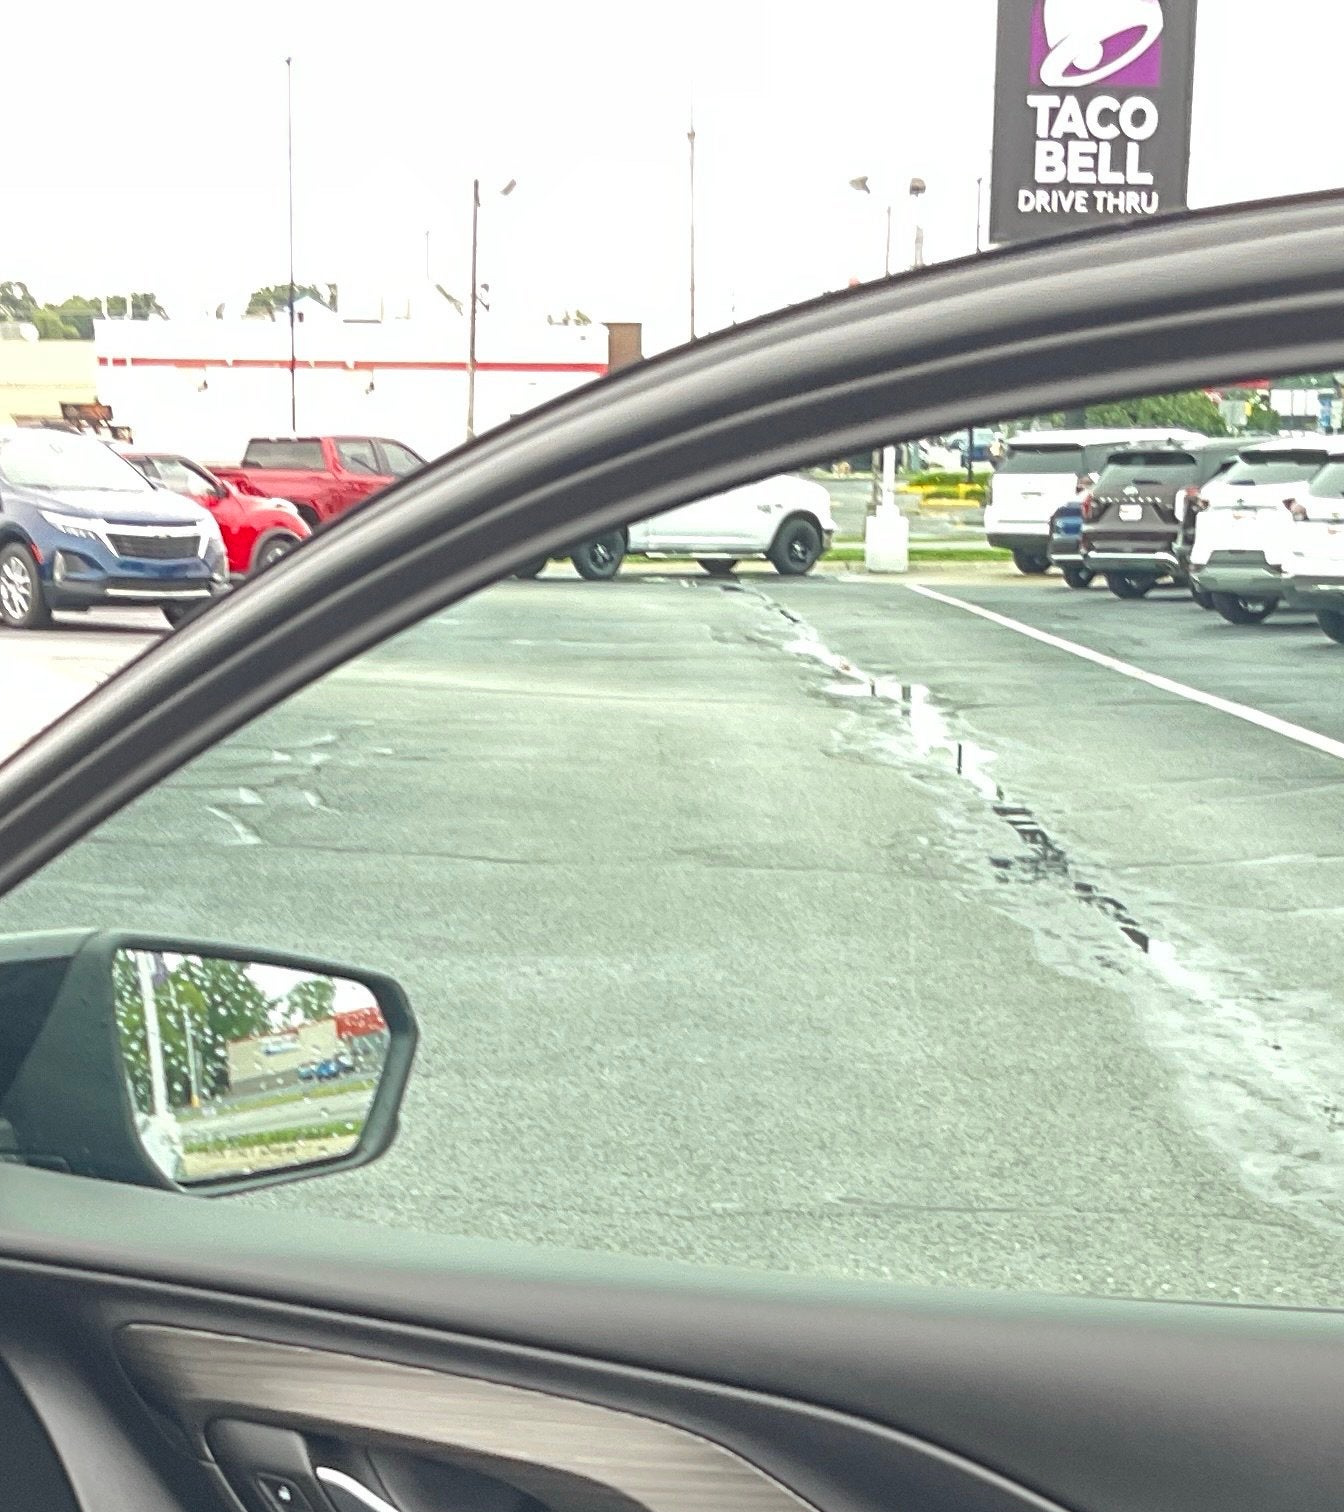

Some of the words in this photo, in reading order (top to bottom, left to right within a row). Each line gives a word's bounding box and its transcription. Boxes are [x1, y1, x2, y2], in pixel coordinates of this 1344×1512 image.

[1026, 94, 1158, 140] TACO
[1034, 140, 1154, 185] BELL
[1017, 189, 1088, 213] DRIVE
[1094, 189, 1159, 214] THRU
